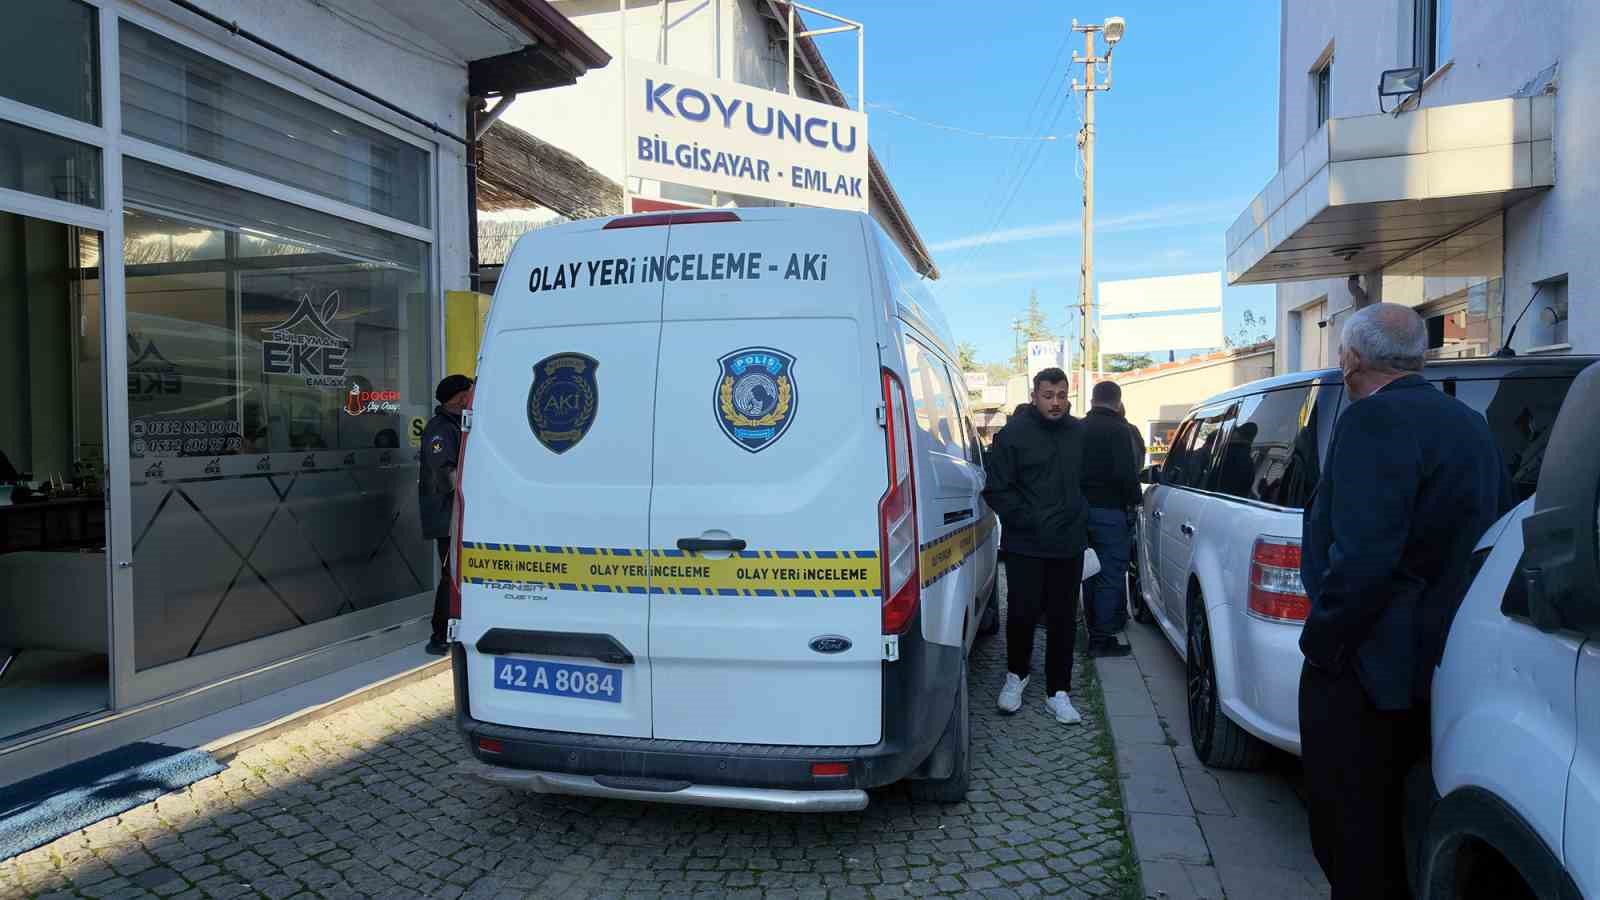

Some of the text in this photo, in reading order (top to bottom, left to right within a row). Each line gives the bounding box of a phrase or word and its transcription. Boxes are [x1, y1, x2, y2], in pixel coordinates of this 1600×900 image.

[646, 79, 856, 153] KOYUNCU
[638, 134, 770, 182] BİLGİSAYAR
[791, 166, 862, 198] EMLAK
[529, 262, 582, 293] OLAY
[262, 340, 349, 377] EKE
[468, 557, 489, 569] OLAY
[590, 564, 619, 576] OLAY
[736, 568, 769, 580] OLAY
[500, 664, 615, 697] 42 A 8084
